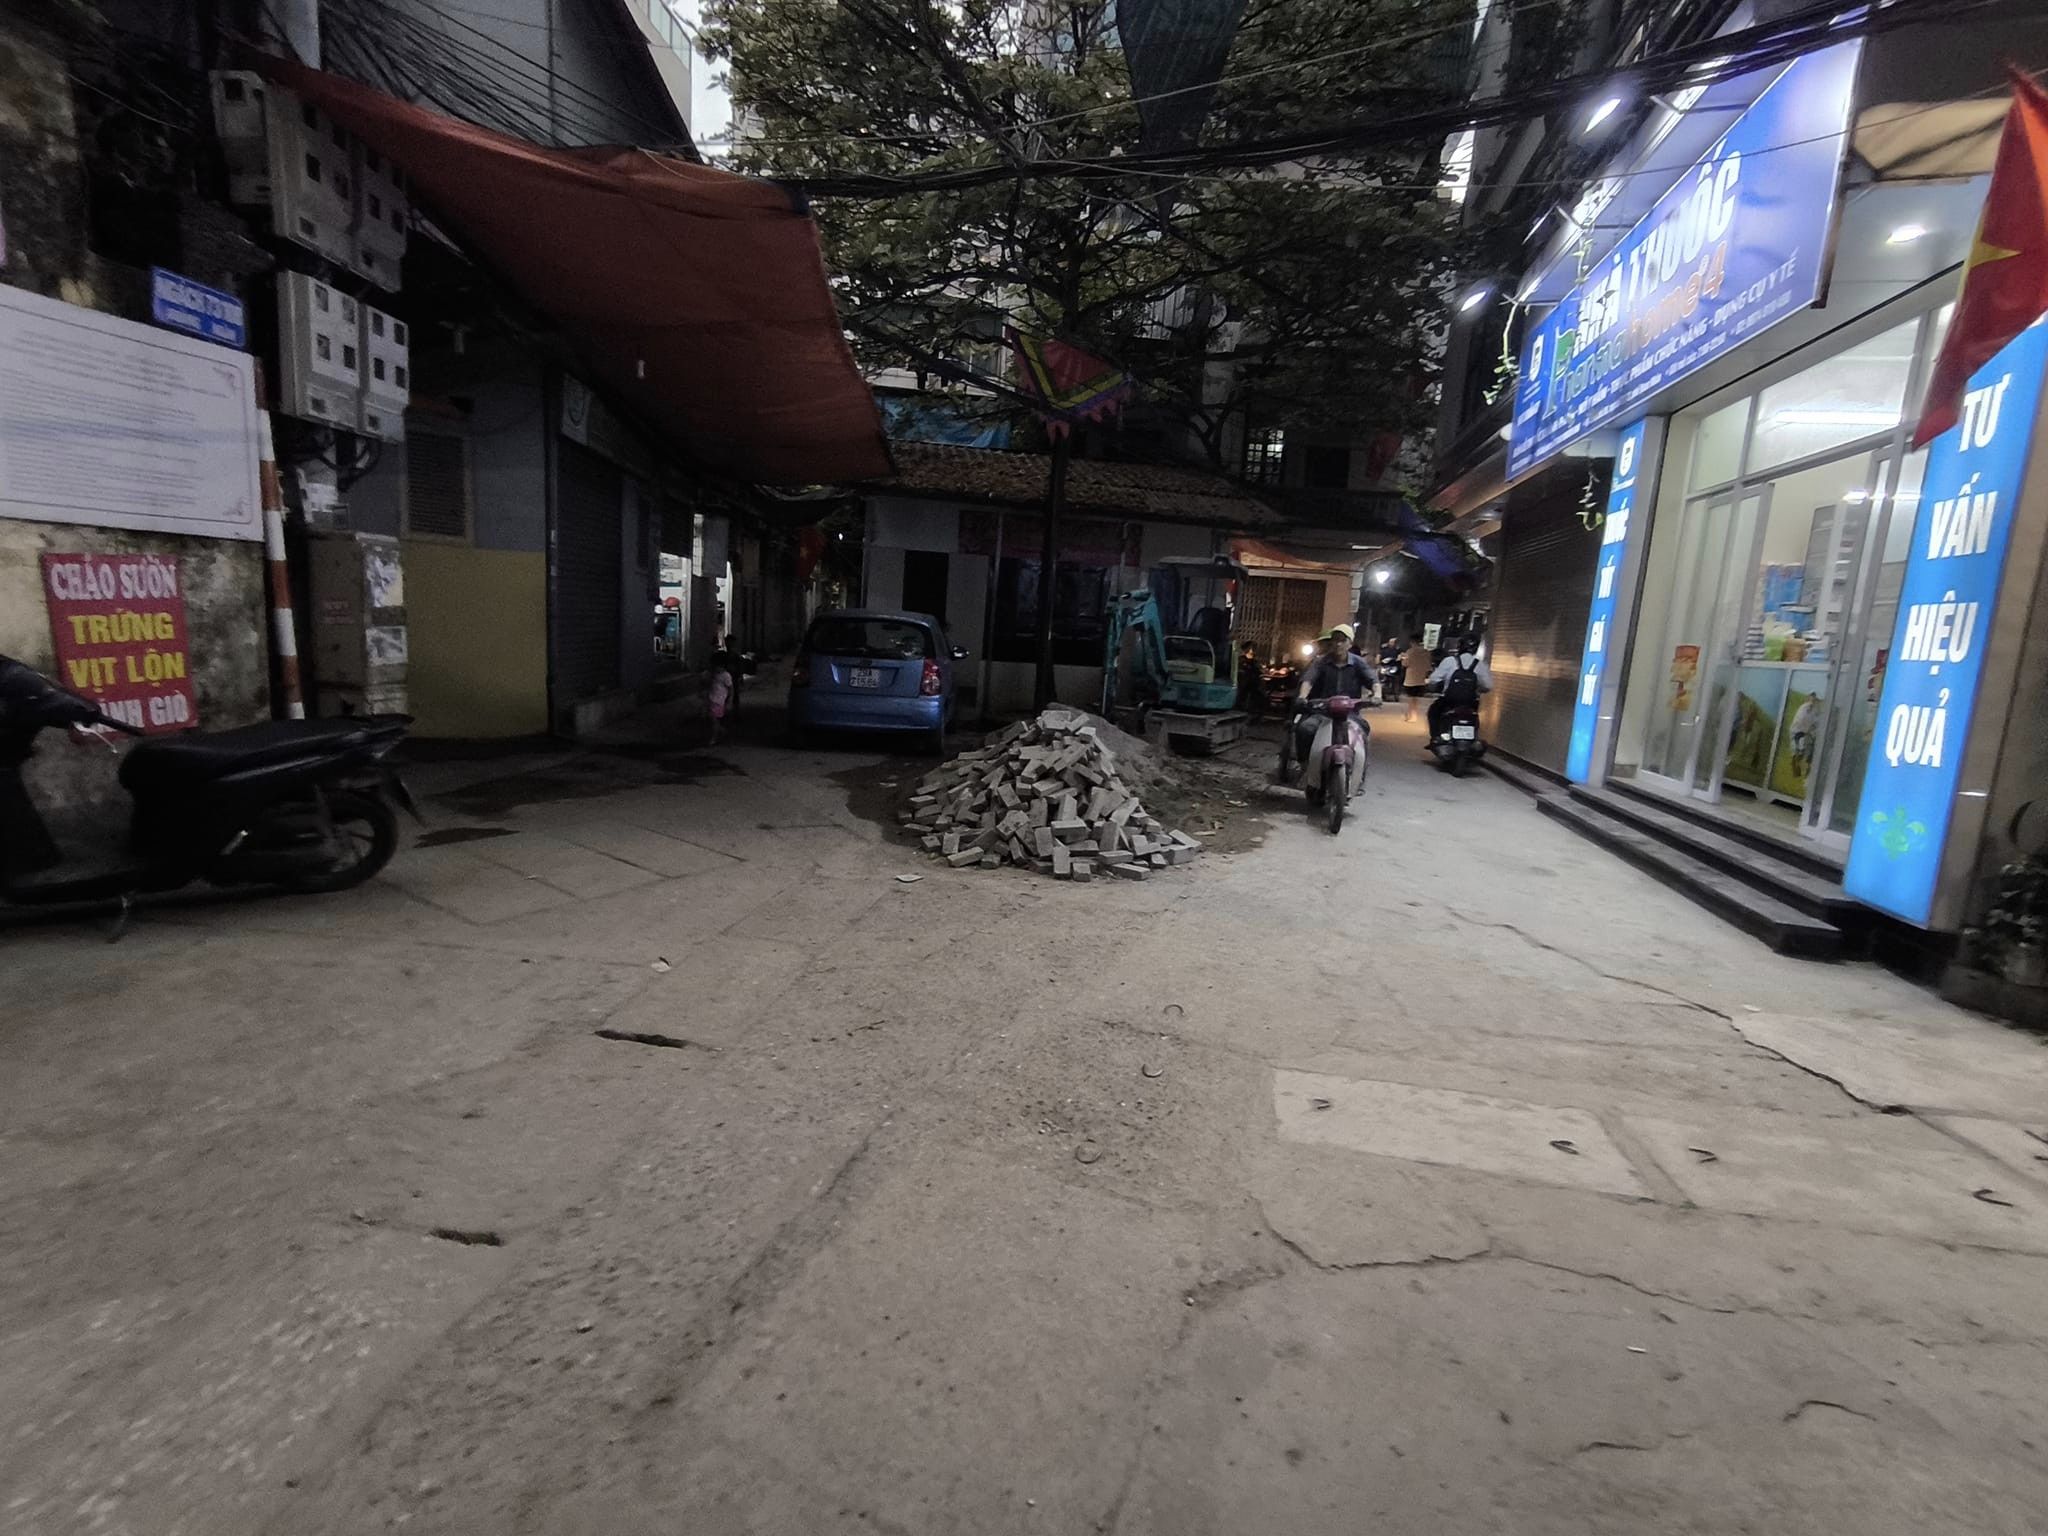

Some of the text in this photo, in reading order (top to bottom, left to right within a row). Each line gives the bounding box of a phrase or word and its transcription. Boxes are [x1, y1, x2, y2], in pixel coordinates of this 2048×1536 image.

[1625, 137, 1742, 319] THUỐC
[1960, 372, 2013, 452] TƯ
[1928, 472, 1999, 560] VẤN
[67, 607, 175, 645] TRỨNG
[1901, 590, 1979, 676] HIỆU
[66, 648, 188, 694] VỊT LỘN
[1885, 687, 1950, 768] QUẢ
